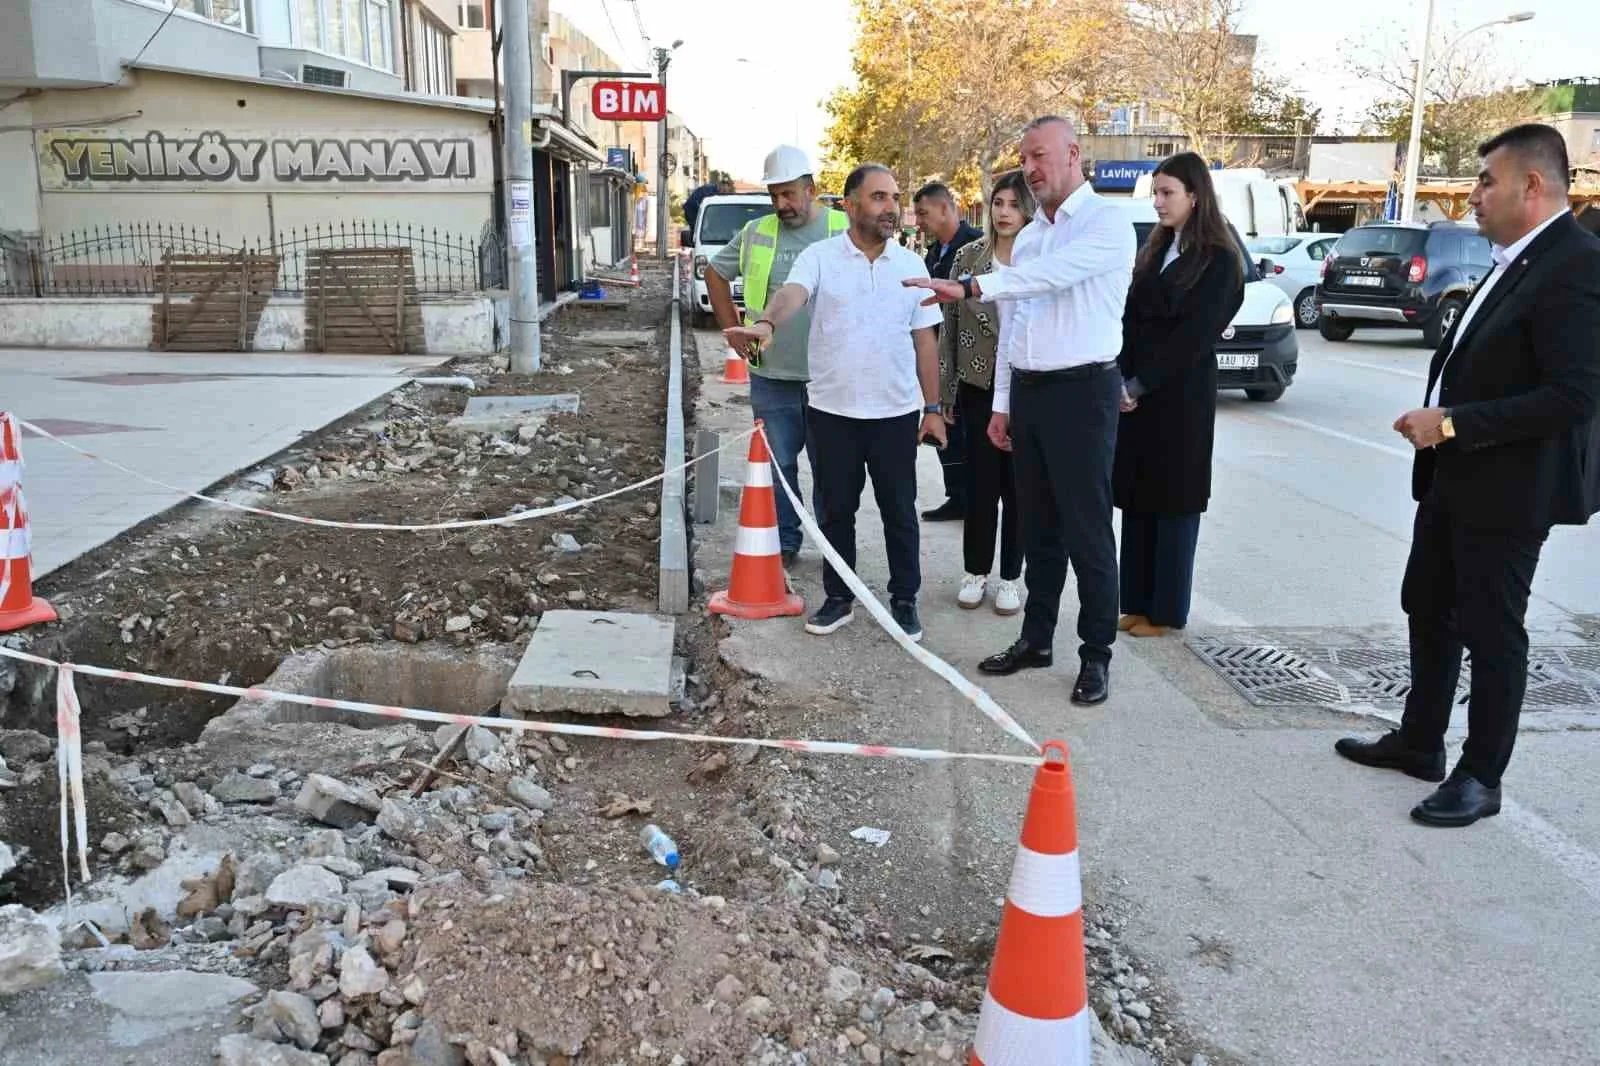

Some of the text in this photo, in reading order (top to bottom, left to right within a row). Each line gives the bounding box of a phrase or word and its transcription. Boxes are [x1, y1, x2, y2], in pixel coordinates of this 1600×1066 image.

[599, 83, 659, 113] BİM
[52, 132, 475, 181] YENİKÖY MANAVI
